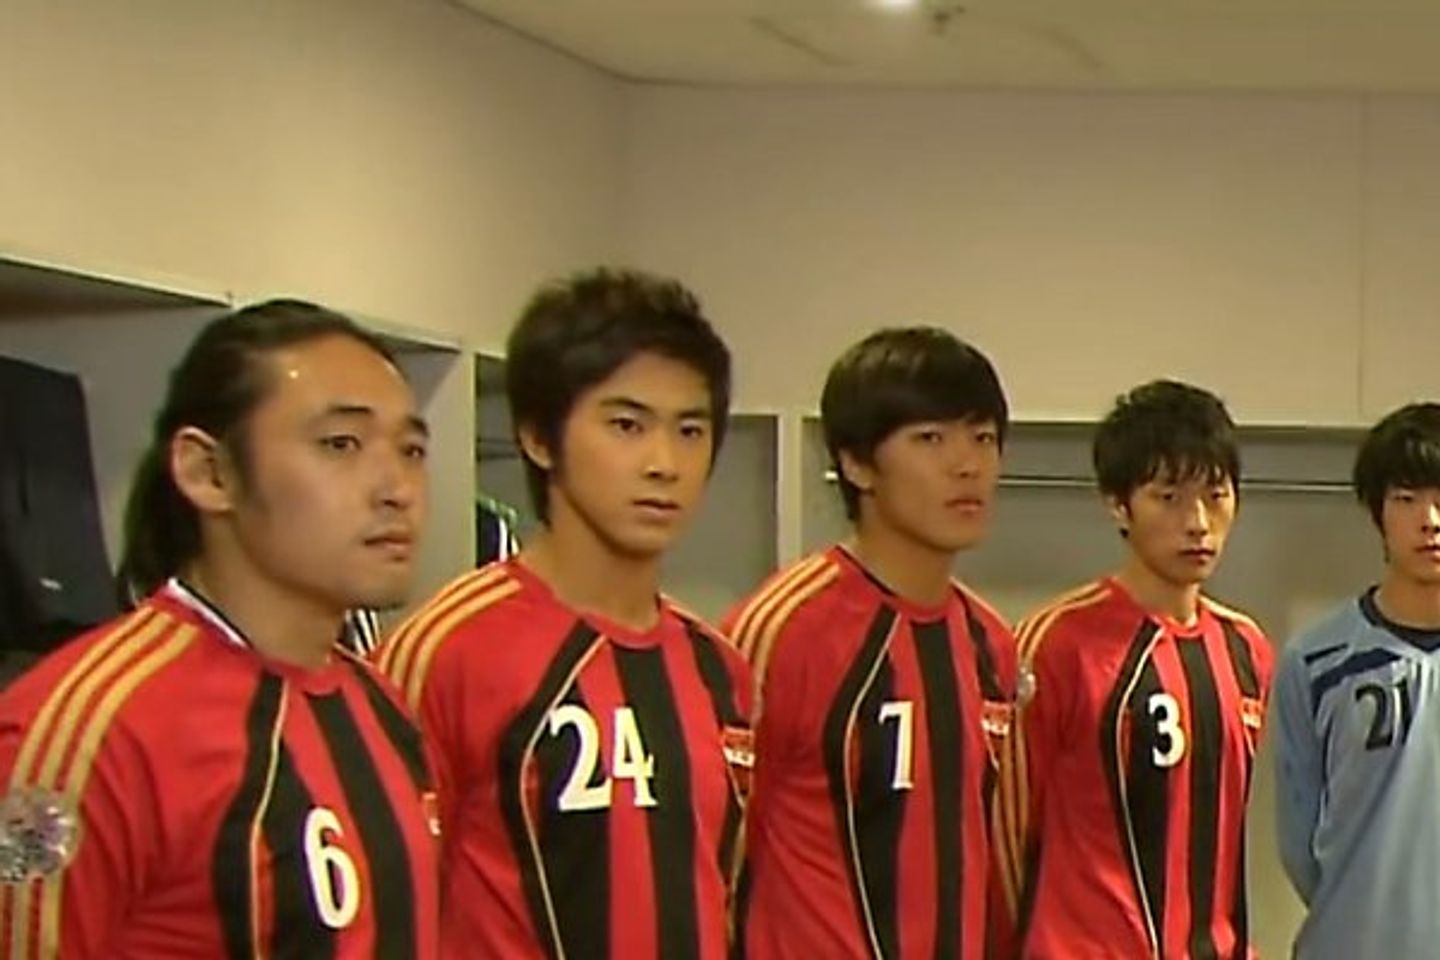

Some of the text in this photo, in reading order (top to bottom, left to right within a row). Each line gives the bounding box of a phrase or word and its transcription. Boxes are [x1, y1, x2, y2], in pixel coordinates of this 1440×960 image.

[549, 705, 658, 812] 24
[1148, 691, 1187, 768] 3
[1355, 677, 1412, 751] 21
[304, 806, 361, 929] 6
